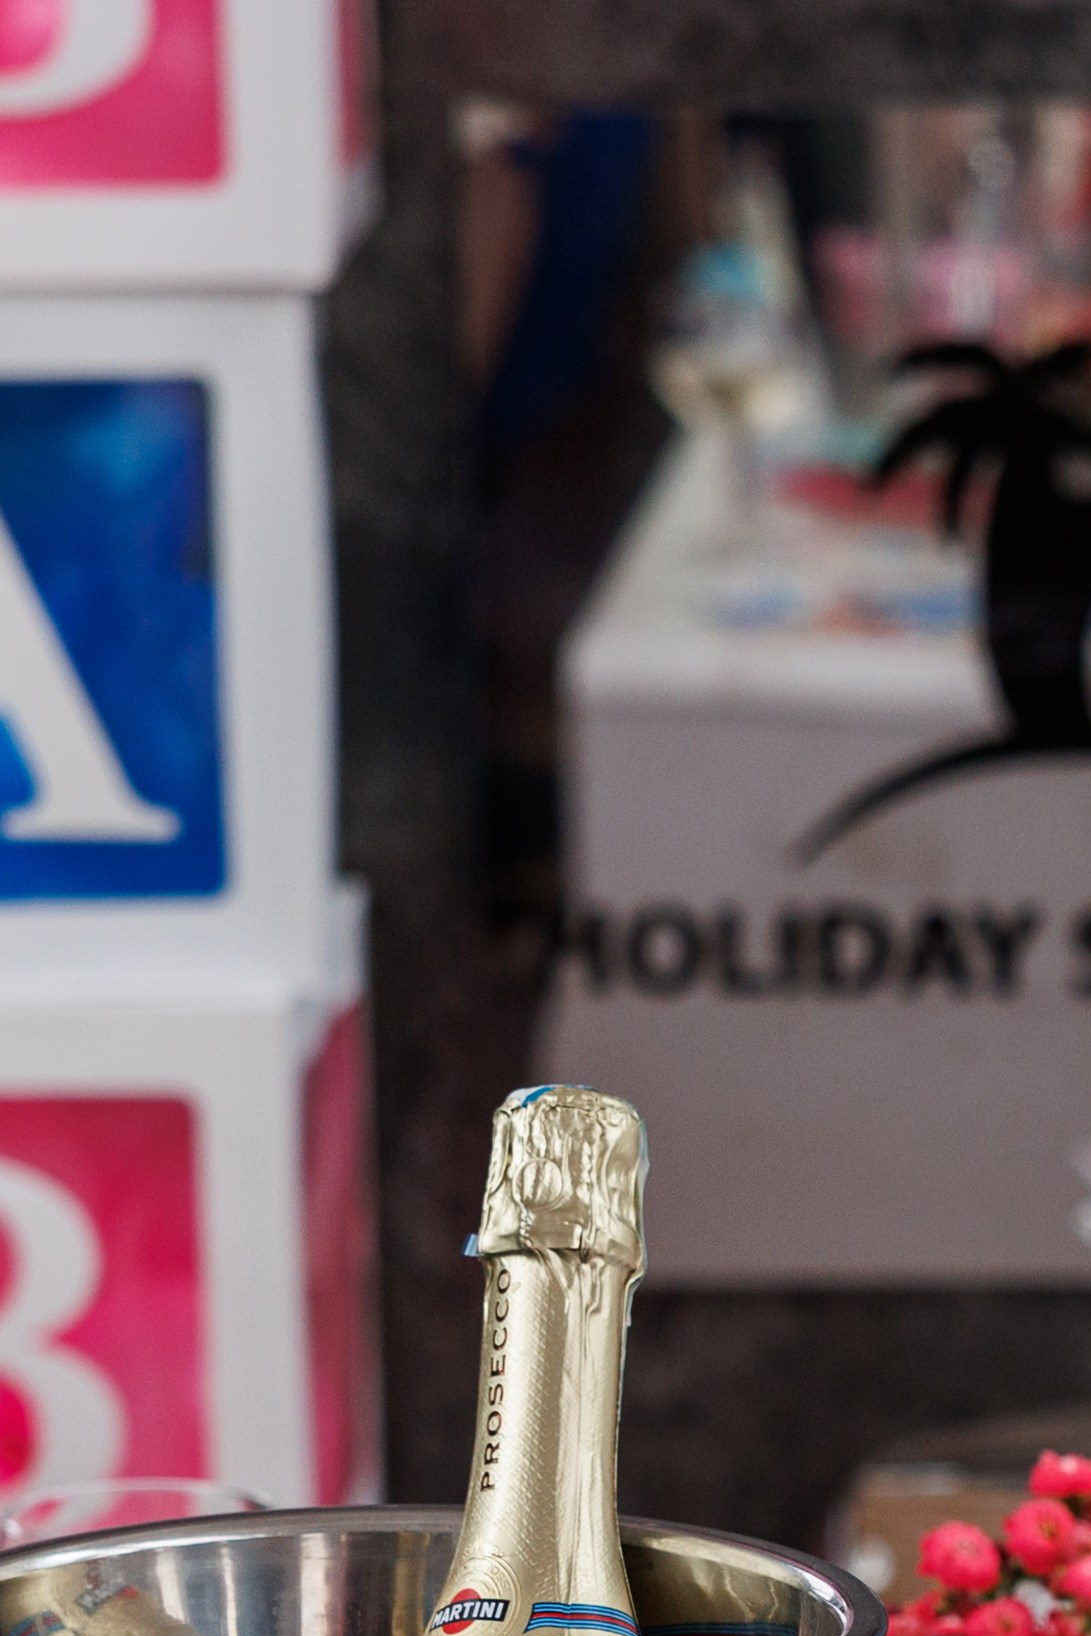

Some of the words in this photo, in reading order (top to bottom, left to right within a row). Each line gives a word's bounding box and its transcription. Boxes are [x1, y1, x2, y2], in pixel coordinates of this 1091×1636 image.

[552, 903, 1038, 997] HOLIDAY
[480, 1268, 511, 1492] PROSECCO
[432, 1601, 505, 1629] MARTINI
